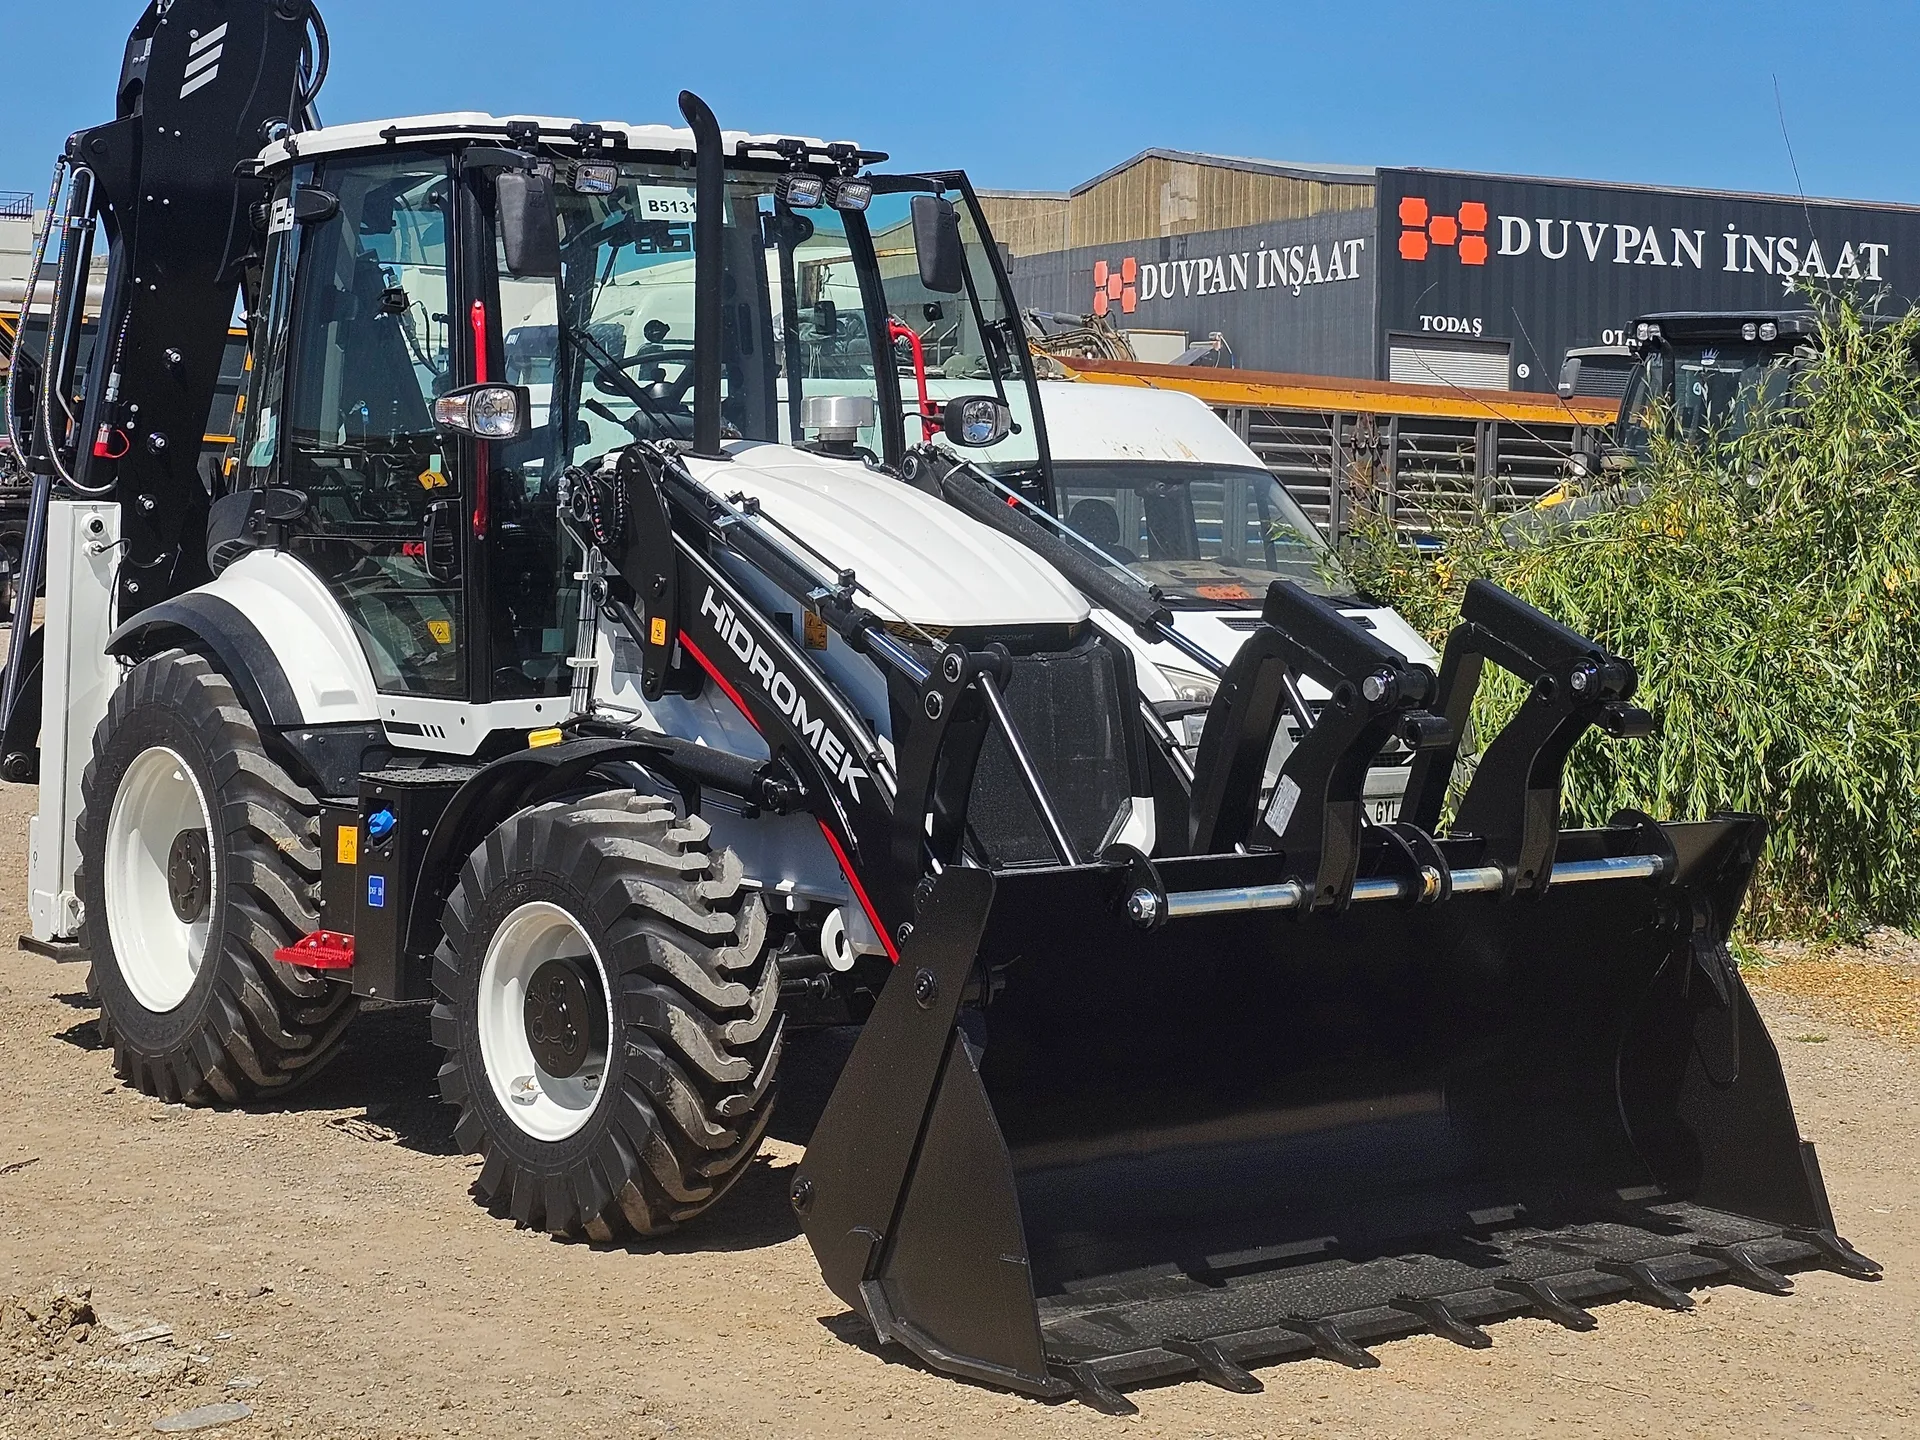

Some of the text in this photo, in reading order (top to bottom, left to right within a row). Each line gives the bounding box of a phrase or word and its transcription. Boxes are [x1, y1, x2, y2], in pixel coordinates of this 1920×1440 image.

[1139, 237, 1366, 302] DUVPAN İNŞAAT
[1497, 215, 1889, 288] DUVPAN İNŞAAT
[1419, 315, 1484, 338] TODAŞ
